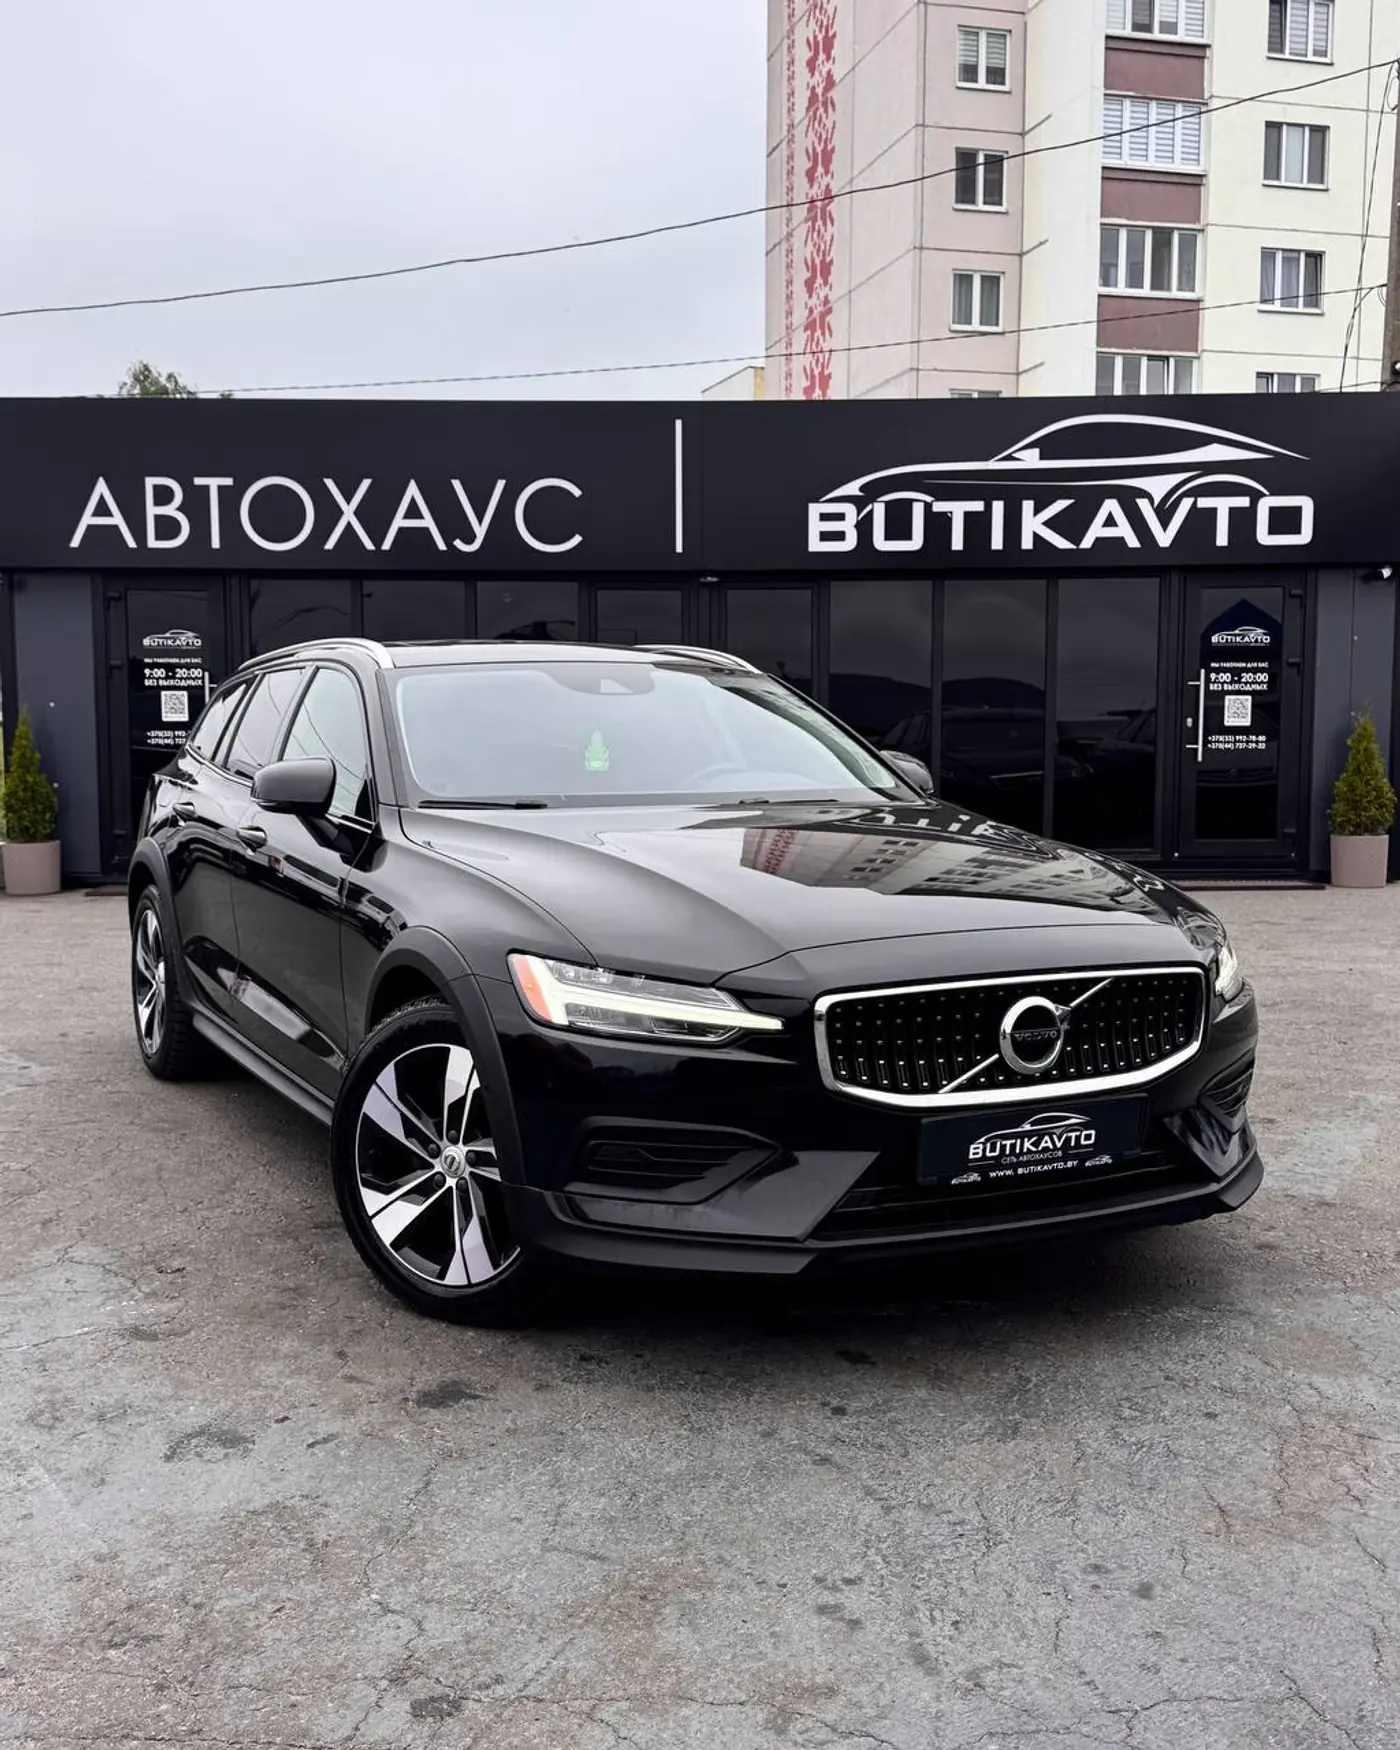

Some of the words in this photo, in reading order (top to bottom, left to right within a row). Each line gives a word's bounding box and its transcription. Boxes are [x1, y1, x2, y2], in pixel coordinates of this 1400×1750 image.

[69, 475, 584, 553] АВТОХАУС
[807, 495, 1314, 553] BUTIKAVTO
[144, 668, 166, 678] 9:00
[175, 668, 203, 678] 20:00
[1210, 672, 1231, 682] 9:00
[1241, 672, 1269, 682] 20:00
[158, 679, 203, 687] ВЫХОДНЫХ
[1223, 683, 1268, 691] ВЫХОДНЫХ
[968, 1130, 1096, 1159] BUTIKAVTO
